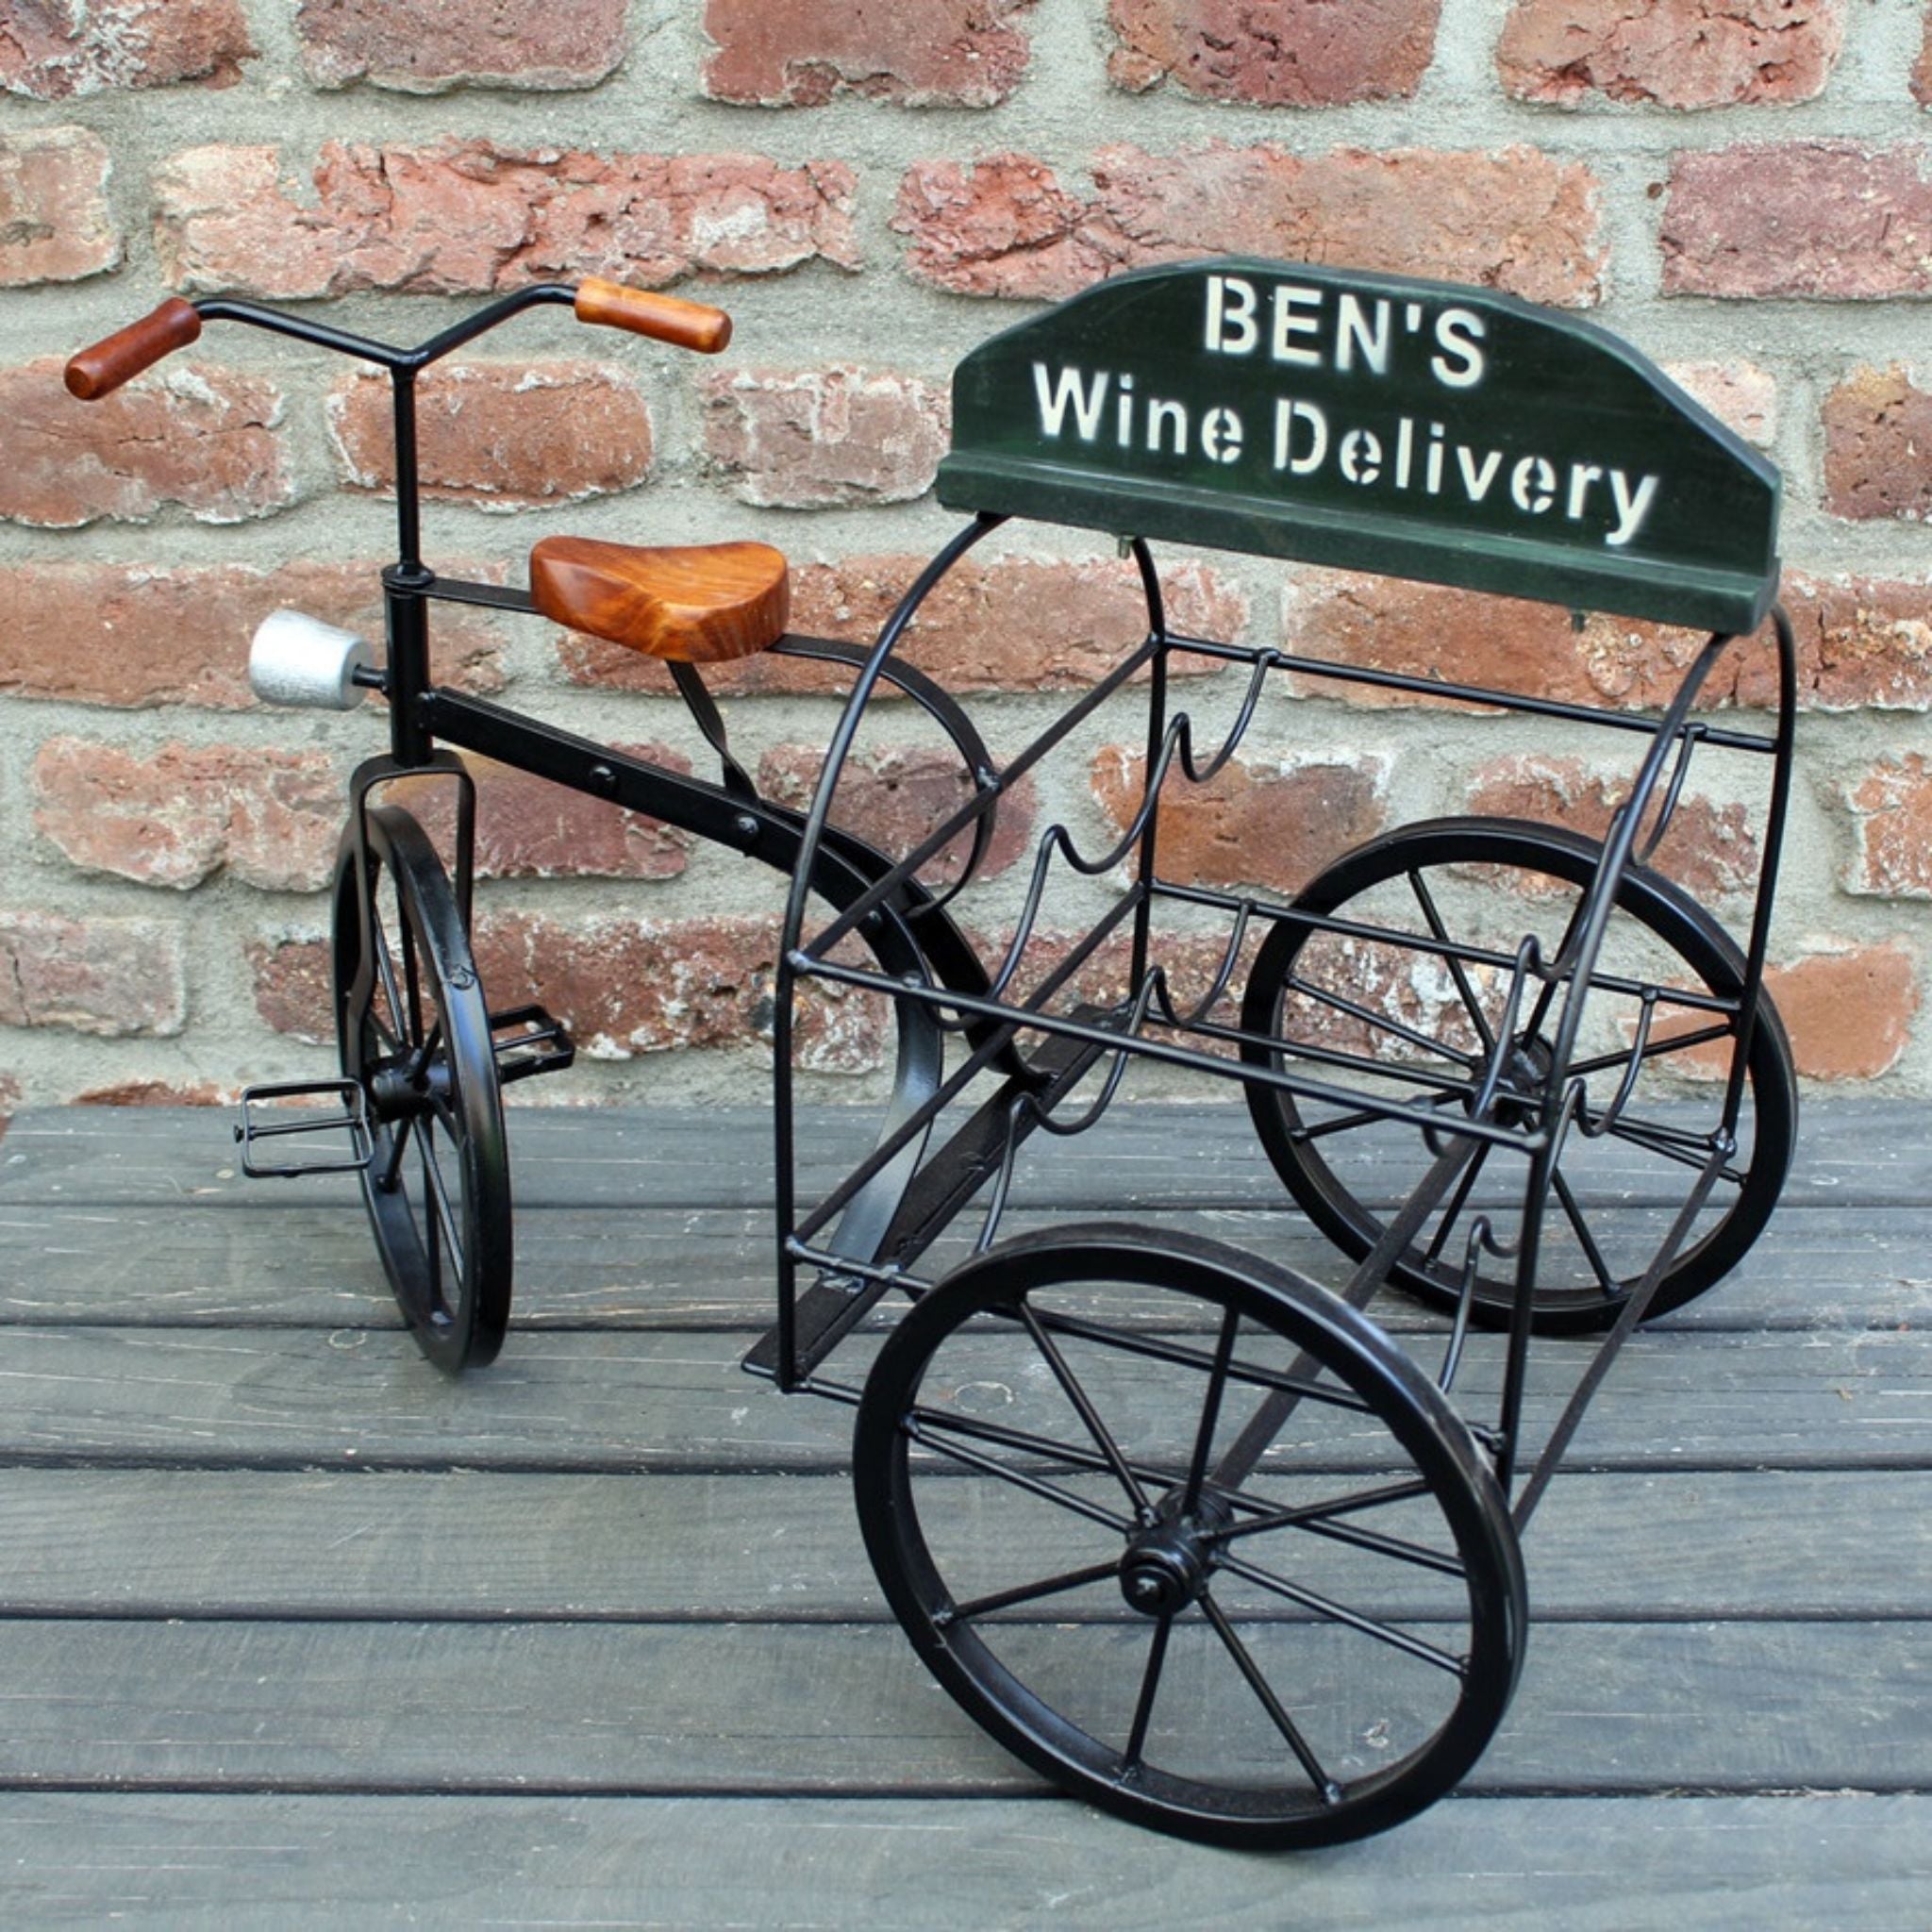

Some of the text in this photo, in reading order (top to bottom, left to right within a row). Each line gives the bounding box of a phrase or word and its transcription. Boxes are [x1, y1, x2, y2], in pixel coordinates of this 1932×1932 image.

[1204, 274, 1487, 390] BEN'S
[1032, 362, 1658, 547] Wine Delivery
